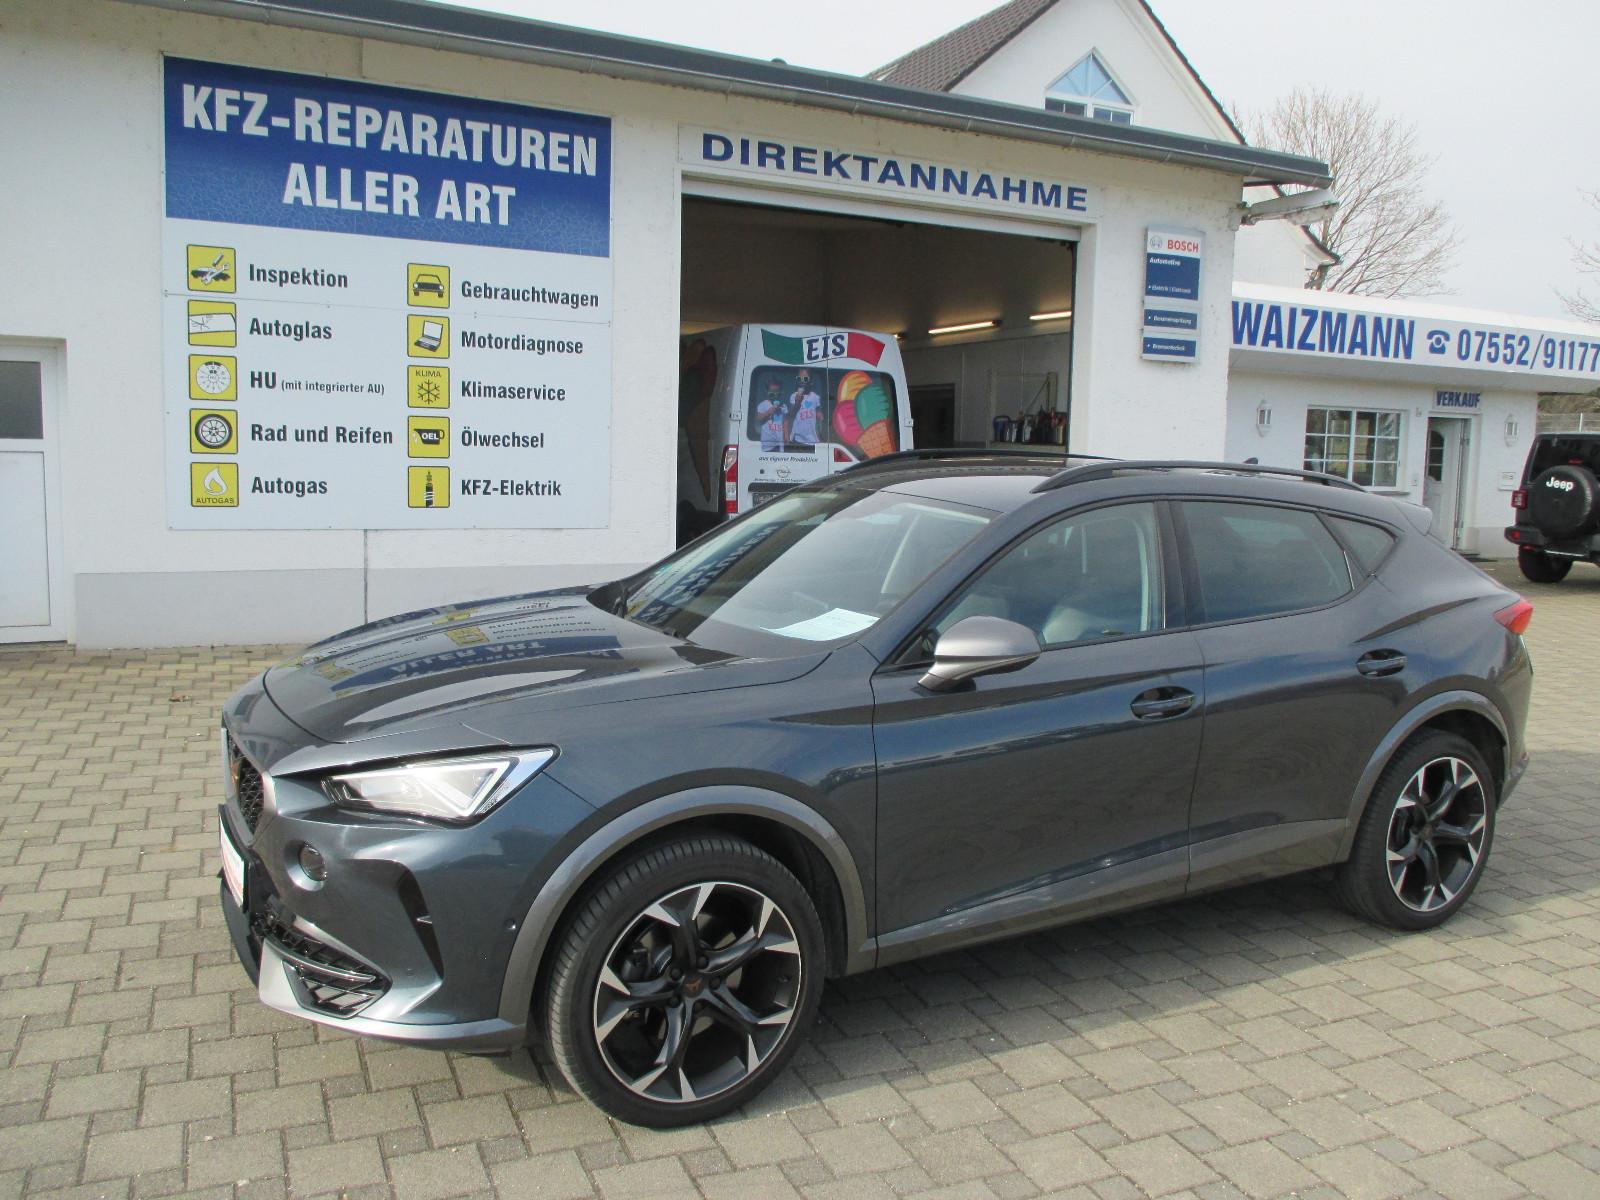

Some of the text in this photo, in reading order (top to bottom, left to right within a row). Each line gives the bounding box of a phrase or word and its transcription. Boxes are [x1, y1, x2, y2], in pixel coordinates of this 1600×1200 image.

[182, 83, 597, 176] KFZ-REPARATUREN
[702, 133, 1088, 212] DIREKTANNAHME
[282, 162, 516, 226] ALLER ART
[1167, 239, 1199, 253] BOSCH
[249, 264, 348, 288] Inspektion
[461, 281, 599, 309] Gebrauchtwagen
[249, 318, 332, 341] Autoglas
[1231, 300, 1415, 360] WAIZMANN
[461, 331, 583, 355] Motordiagnose
[806, 334, 845, 361] EIS
[250, 371, 385, 396] HU (mit integrierter AU)
[415, 369, 442, 378] KLIMA
[461, 381, 566, 401] Klimaservice
[1436, 391, 1480, 408] VERKAUF
[251, 424, 393, 444] Rad und Reifen
[421, 432, 439, 440] OEL
[461, 427, 544, 448] Ölwechsel
[251, 476, 328, 498] Autogas
[461, 479, 561, 496] KFZ-Elektrik
[1545, 476, 1574, 492] Jeep
